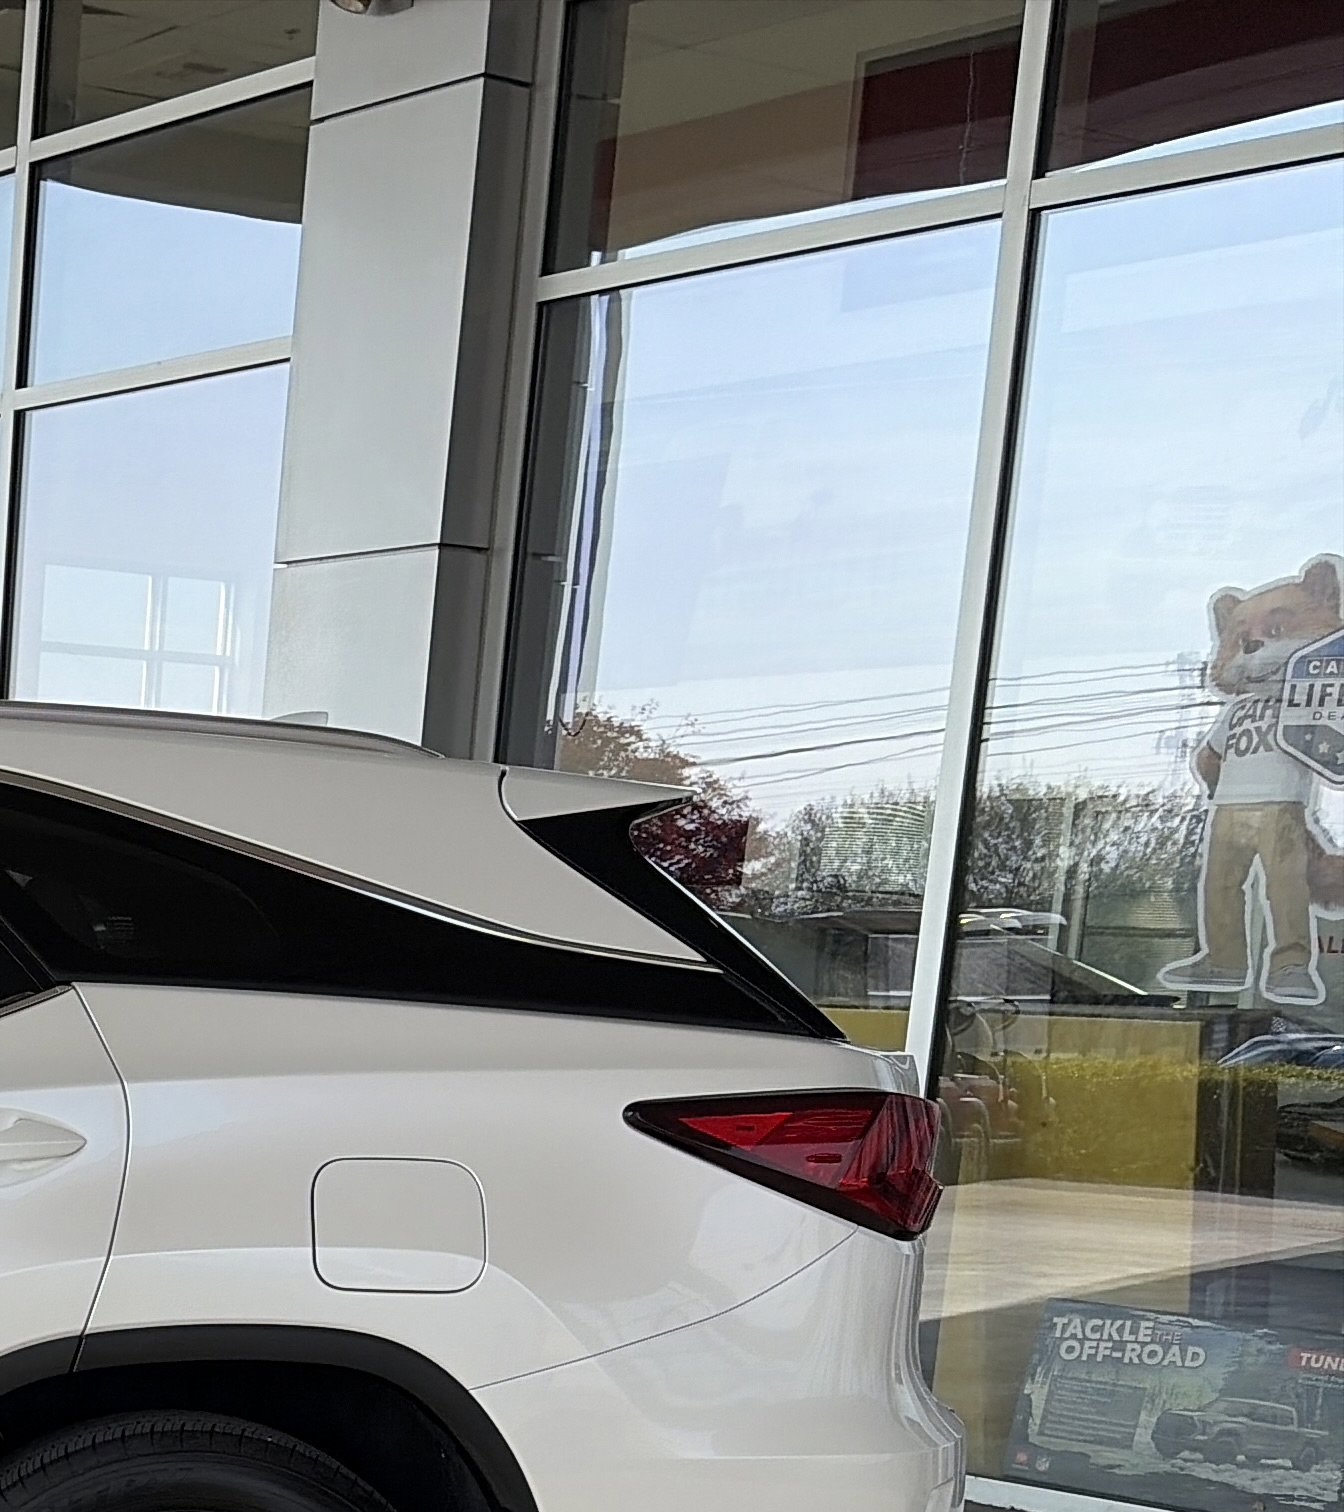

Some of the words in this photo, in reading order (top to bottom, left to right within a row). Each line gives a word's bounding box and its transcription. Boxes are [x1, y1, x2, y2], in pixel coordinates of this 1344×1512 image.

[1223, 724, 1275, 762] FOX
[1053, 1316, 1154, 1342] TACKLE
[1155, 1330, 1183, 1344] THE
[1059, 1339, 1206, 1368] OFF-ROAD
